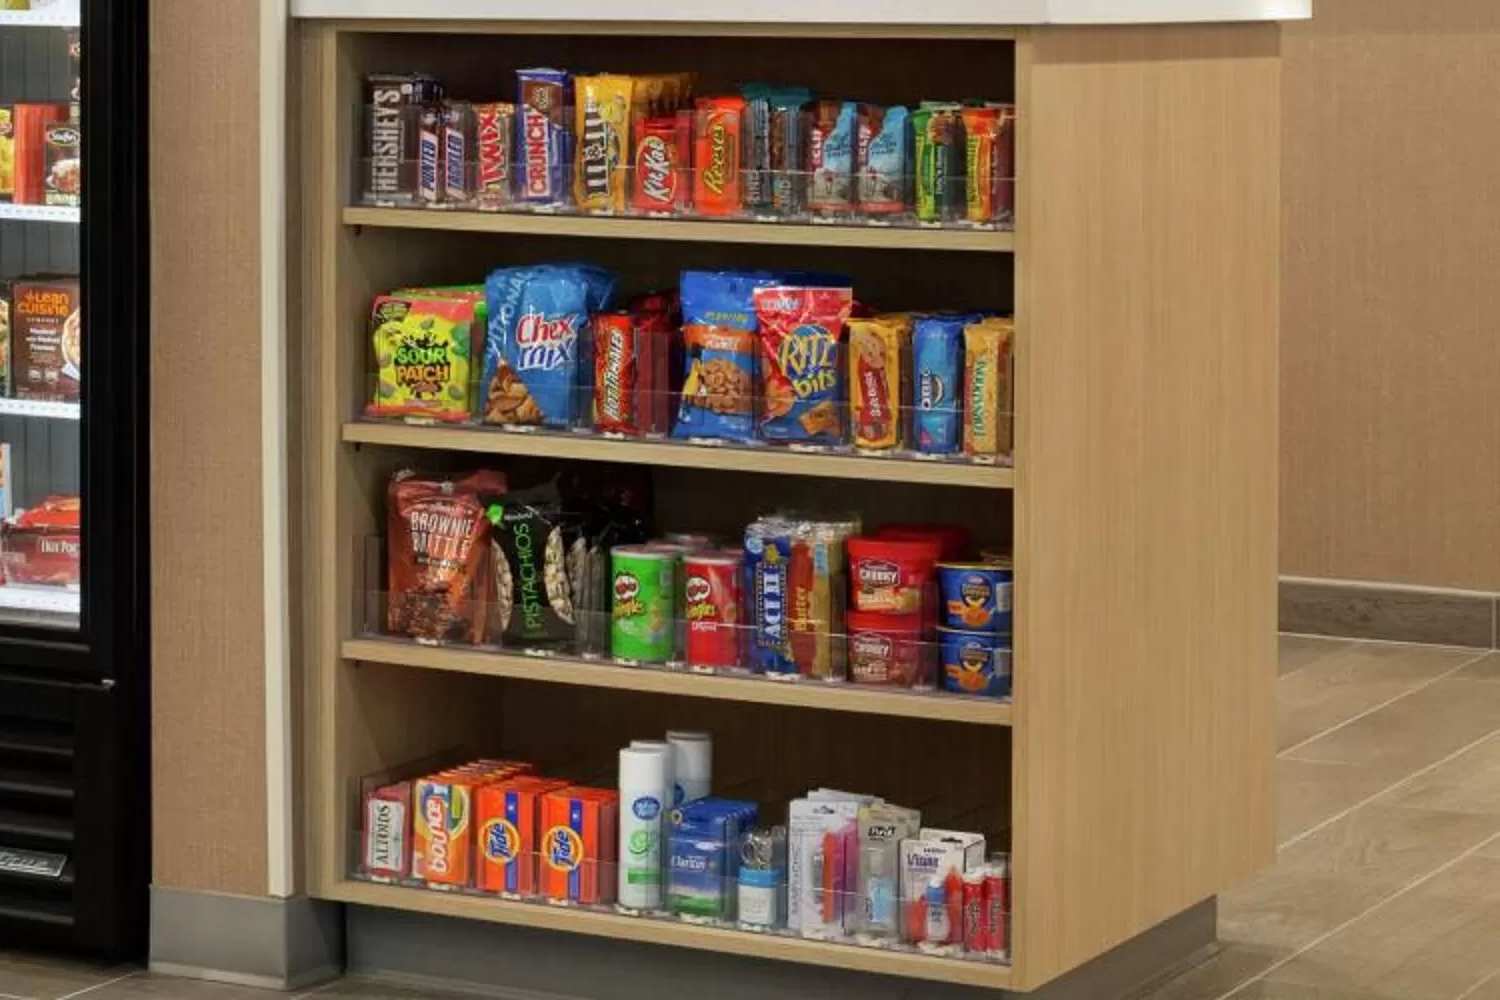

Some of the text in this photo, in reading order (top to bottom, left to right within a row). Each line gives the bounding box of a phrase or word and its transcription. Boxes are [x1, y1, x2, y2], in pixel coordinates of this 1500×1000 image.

[372, 86, 401, 193] HERSHEY'S
[479, 111, 504, 186] TWIX
[527, 114, 548, 194] CRUNCH
[515, 312, 578, 345] Chex
[396, 346, 446, 365] SOUR
[778, 332, 834, 371] RITZ
[396, 364, 450, 383] PATCH
[795, 367, 838, 398] bits
[920, 367, 933, 411] OREO
[411, 511, 474, 538] BROWNIE
[513, 522, 543, 630] PISTACHIOS
[763, 598, 781, 641] ACT
[375, 803, 392, 867] ALTOIDS
[426, 796, 450, 874] bounce
[488, 822, 512, 859] Tide
[552, 829, 575, 868] Tide
